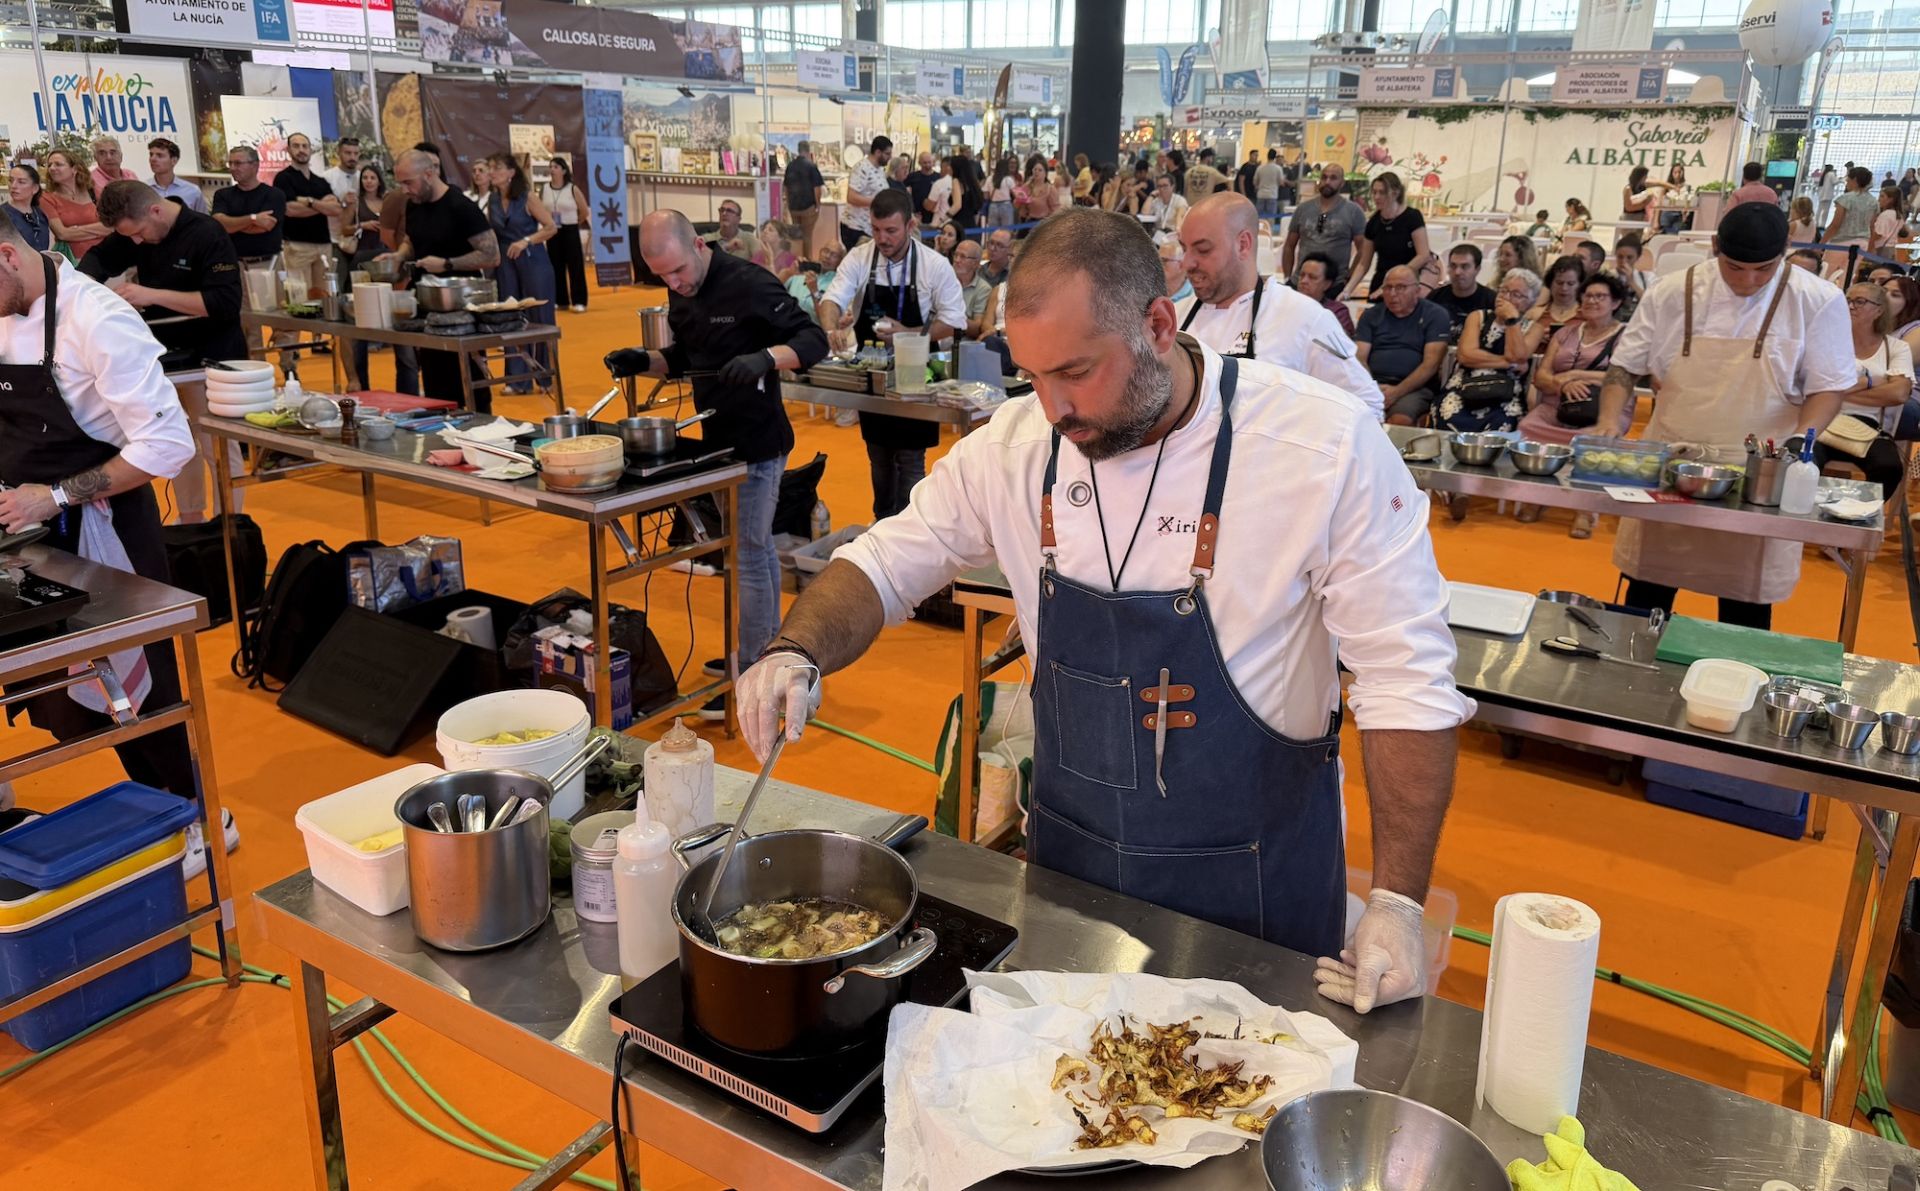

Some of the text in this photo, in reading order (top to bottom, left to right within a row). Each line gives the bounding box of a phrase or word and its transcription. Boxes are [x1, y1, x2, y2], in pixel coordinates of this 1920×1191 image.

[173, 12, 187, 22] LA
[232, 2, 246, 12] DE
[261, 11, 281, 24] IFA
[543, 28, 656, 52] CALLOSA DE SEGURA
[33, 92, 177, 133] LA NUCIA
[1624, 120, 1709, 148] Saborea
[1565, 147, 1707, 168] ALBATERA
